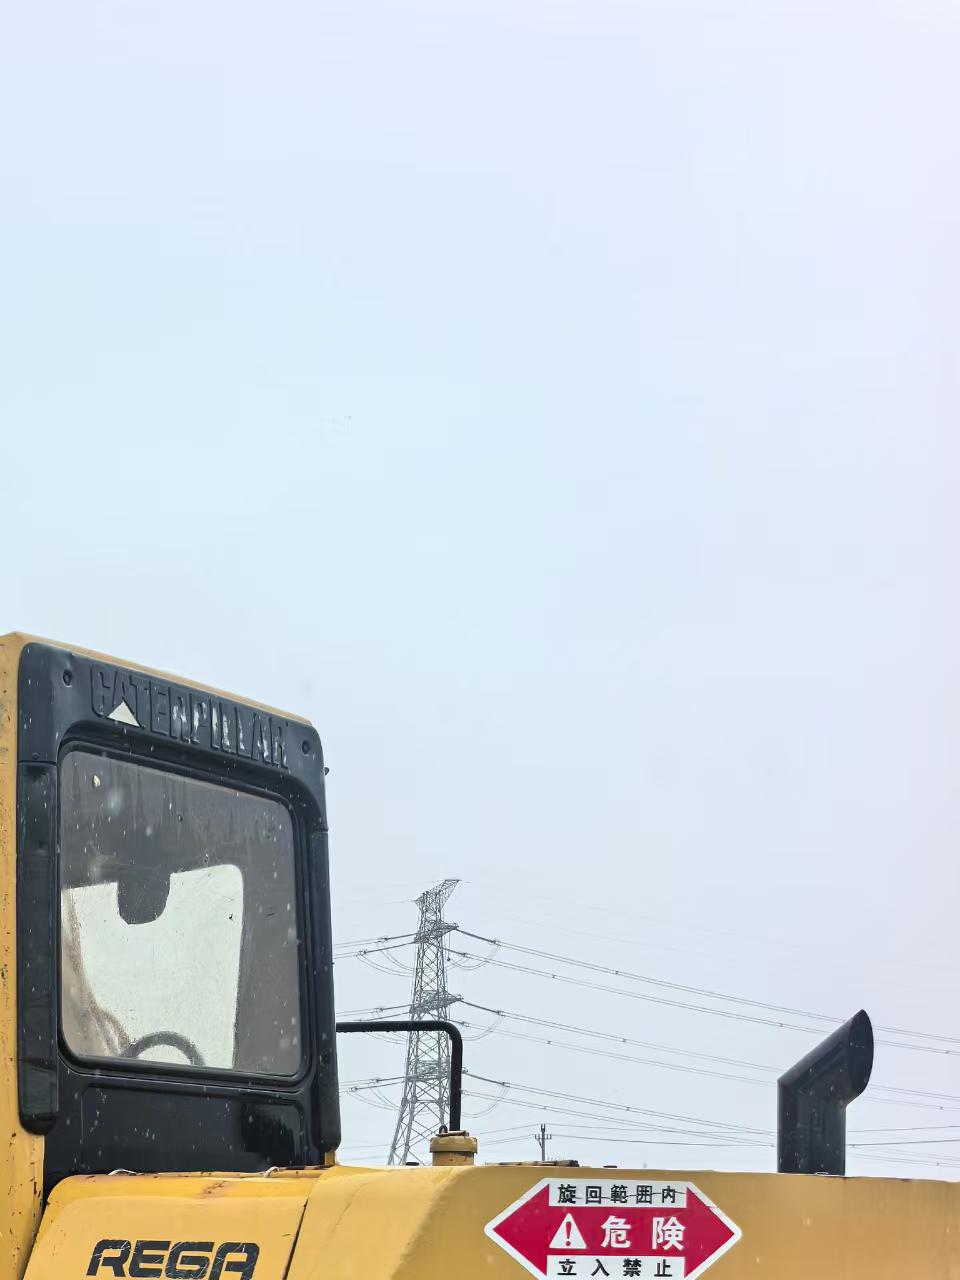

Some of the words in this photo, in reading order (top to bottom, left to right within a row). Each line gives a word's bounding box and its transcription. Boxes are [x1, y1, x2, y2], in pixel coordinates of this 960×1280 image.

[557, 1184, 676, 1205] 旋回範囲内
[600, 1215, 686, 1250] 危険
[557, 1258, 673, 1278] 立入禁止
